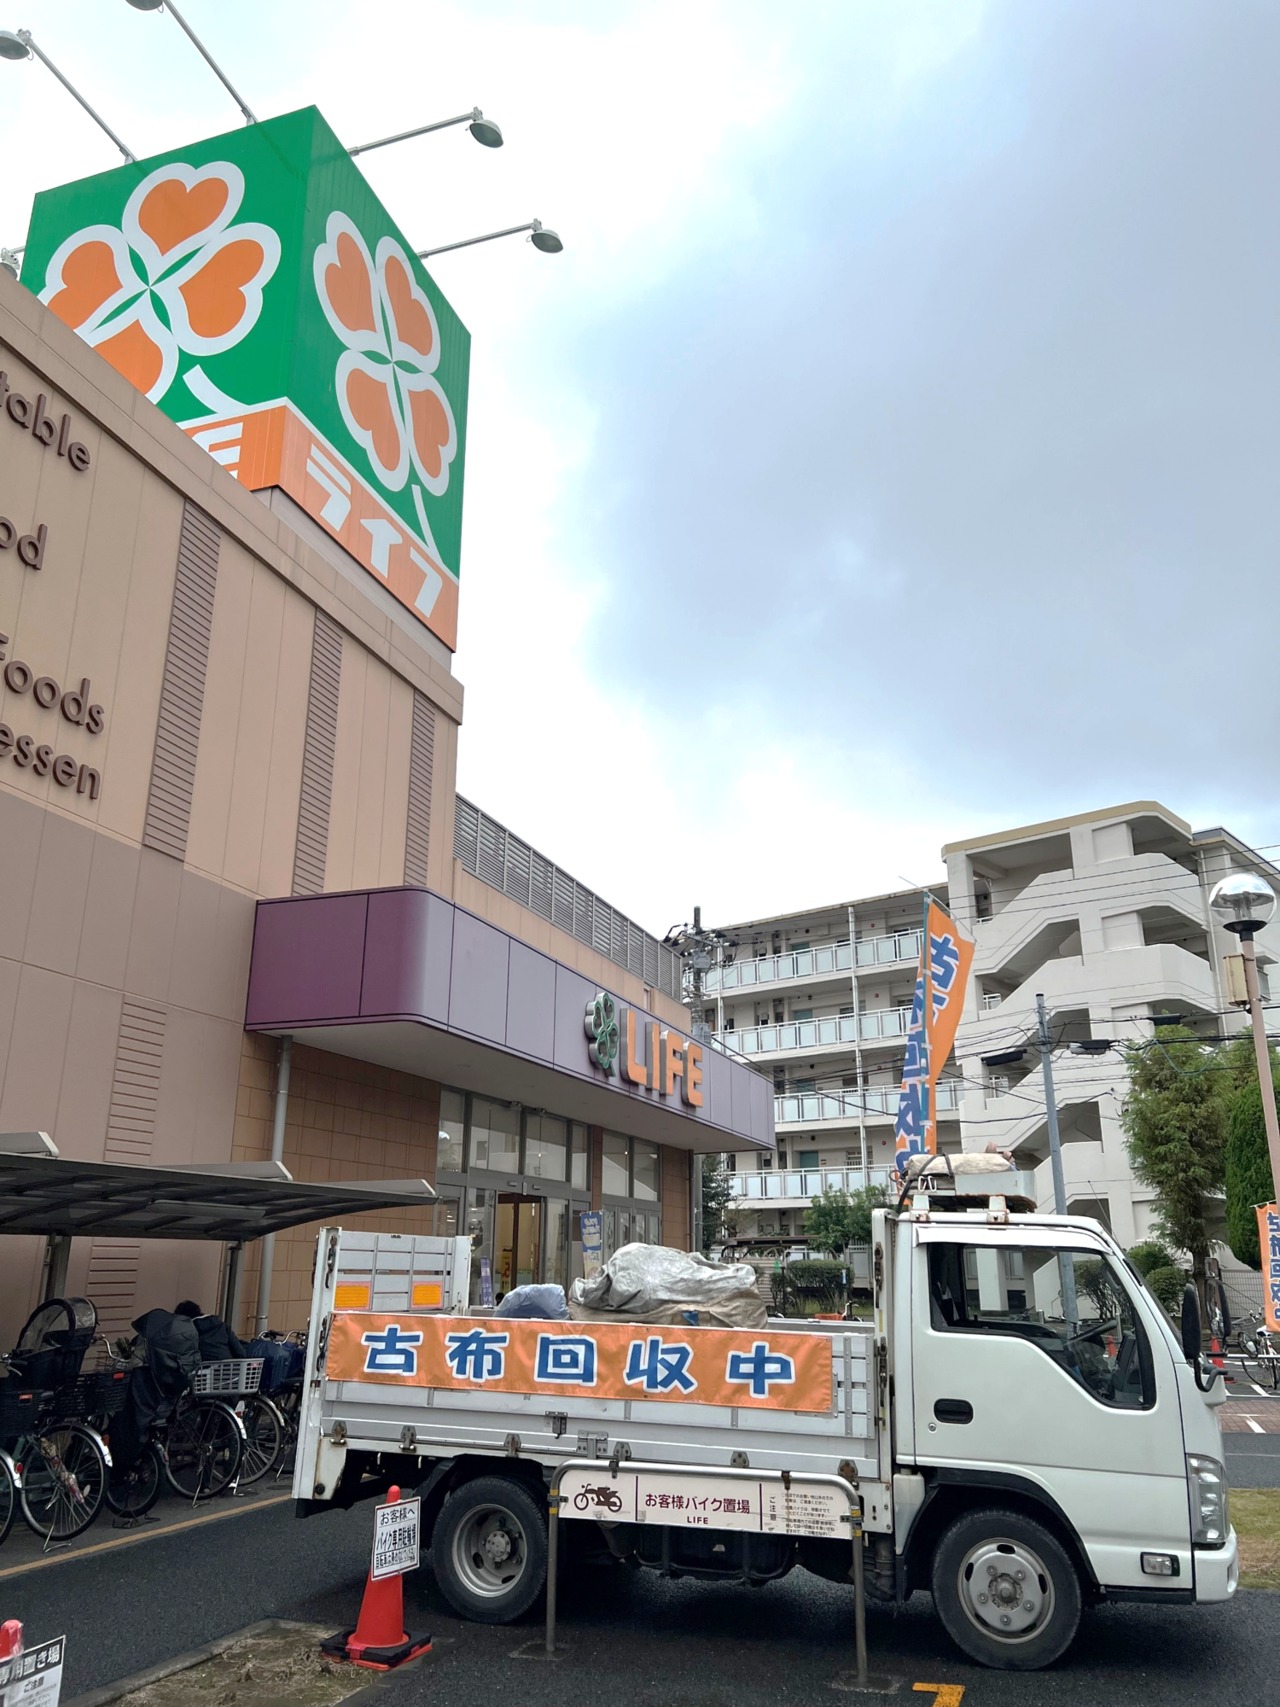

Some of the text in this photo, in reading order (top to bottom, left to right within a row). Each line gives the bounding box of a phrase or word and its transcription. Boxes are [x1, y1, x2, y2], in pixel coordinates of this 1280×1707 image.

[306, 443, 443, 618] ライフ
[620, 1007, 704, 1108] LIFE
[362, 1325, 796, 1398] 古布回収中
[381, 1508, 415, 1525] お客様へ
[645, 1493, 750, 1514] お客様バイク置場
[687, 1516, 709, 1525] LIFE
